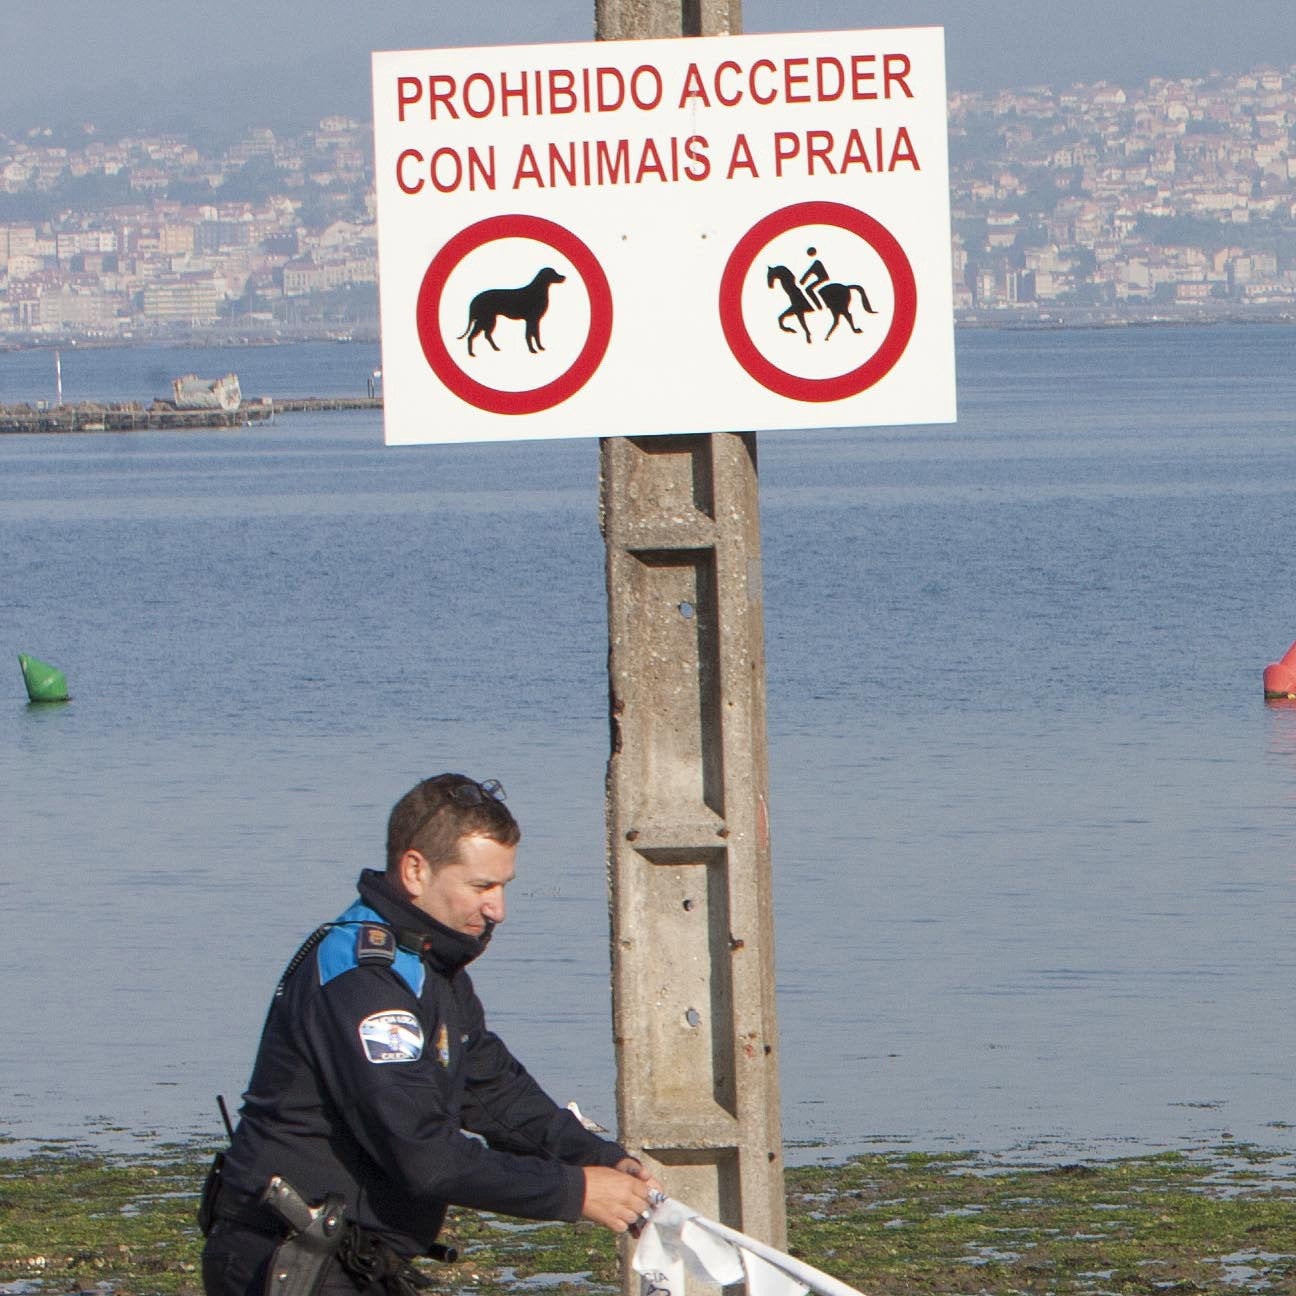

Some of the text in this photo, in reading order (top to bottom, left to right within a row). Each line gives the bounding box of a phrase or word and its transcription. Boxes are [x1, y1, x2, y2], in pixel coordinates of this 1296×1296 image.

[397, 53, 915, 121] PROHIBIDO ACCEDER
[396, 126, 921, 195] CON ANIMAIS A PRAIA
